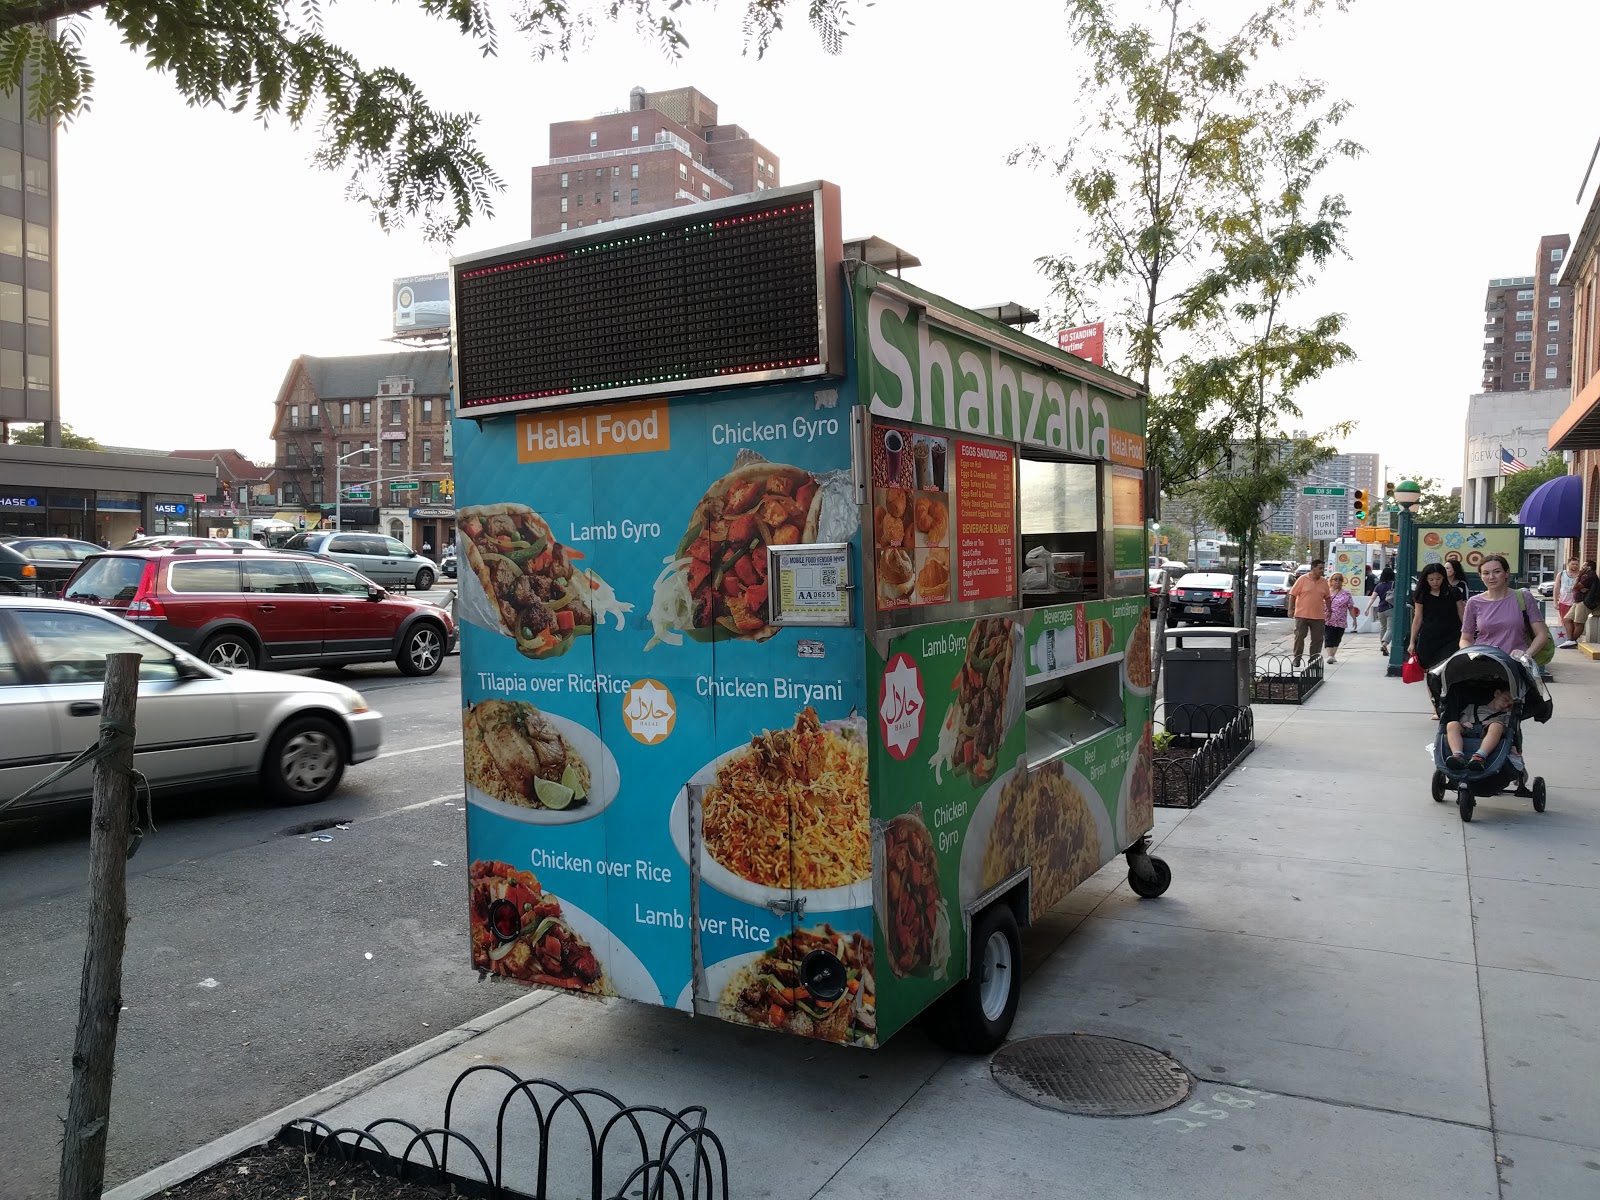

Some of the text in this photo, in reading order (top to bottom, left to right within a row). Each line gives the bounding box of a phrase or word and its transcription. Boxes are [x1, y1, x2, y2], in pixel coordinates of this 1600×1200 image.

[1060, 328, 1096, 343] NO STANDING
[867, 284, 1110, 461] Shahzada
[526, 409, 659, 452] Halal Food
[712, 415, 840, 446] Chicken Gyro
[962, 445, 1008, 461] EGGS SANDWICHES
[1111, 434, 1142, 460] Halal Food
[0, 498, 26, 506] HASE
[570, 520, 661, 544] Lamb Gyro
[962, 524, 989, 533] BEVERAGE
[990, 524, 993, 533] &
[1524, 527, 1536, 536] TM
[1044, 608, 1073, 626] Beverages
[922, 634, 967, 658] Lamb Gyro
[478, 672, 527, 696] Tilapia
[530, 678, 563, 693] over
[696, 676, 842, 706] Chicken Biryani
[934, 800, 968, 828] Chicken
[938, 829, 959, 851] Gyro
[531, 850, 672, 883] Chicken over Rice
[635, 904, 770, 943] Lamb ver Rice
